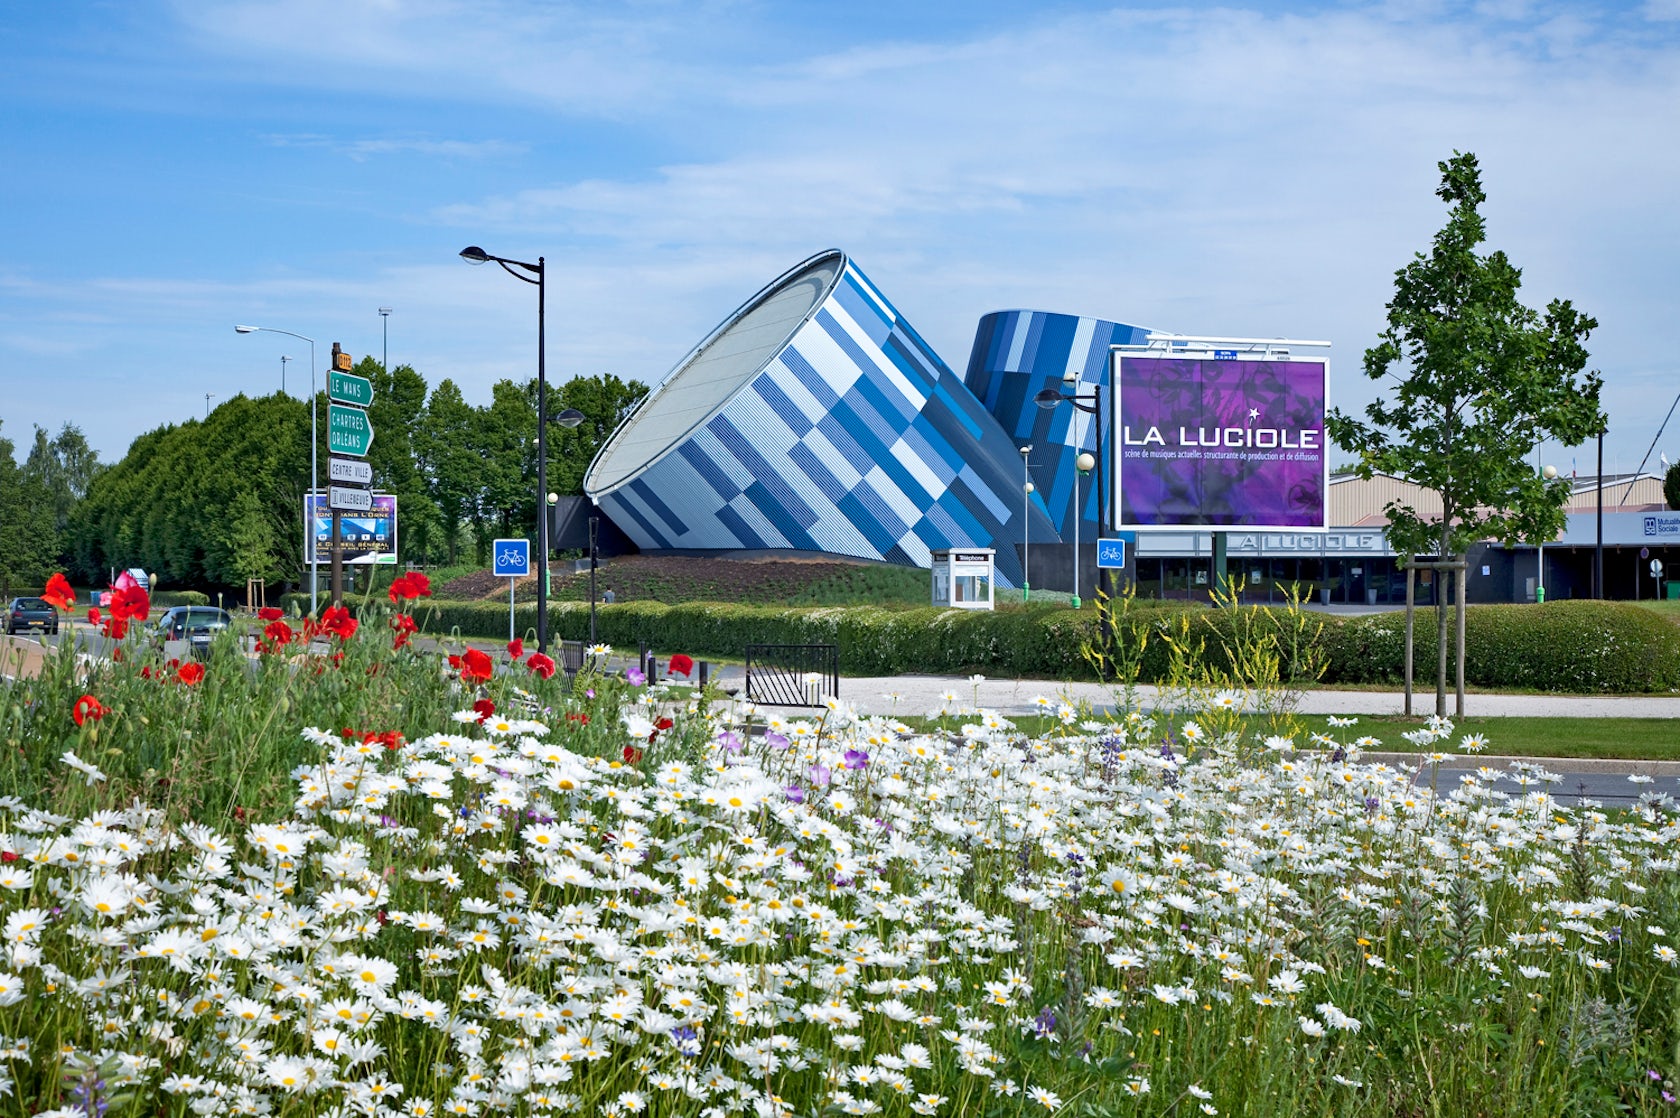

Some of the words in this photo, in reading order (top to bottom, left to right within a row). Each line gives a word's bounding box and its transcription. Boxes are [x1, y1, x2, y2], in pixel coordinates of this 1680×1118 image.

[332, 379, 339, 392] LE
[343, 381, 361, 397] MANS
[332, 413, 363, 431] CHARTRES
[332, 431, 360, 448] ORLÉANS
[1124, 426, 1166, 446] LA
[1179, 426, 1319, 449] LUCIOLE
[1124, 449, 1140, 458] scène
[1141, 449, 1149, 458] de
[1150, 449, 1176, 460] musiques
[1178, 449, 1203, 458] actuelles
[1203, 450, 1238, 459] structurante
[1239, 451, 1247, 460] de
[1248, 451, 1278, 462] production
[1279, 452, 1285, 461] et
[1286, 452, 1294, 461] de
[1294, 452, 1319, 461] diffusion
[332, 464, 352, 477] CENTRE
[355, 466, 368, 478] VILLE
[339, 492, 369, 505] VILLENEUVE
[1261, 535, 1373, 549] LUCIOLE
